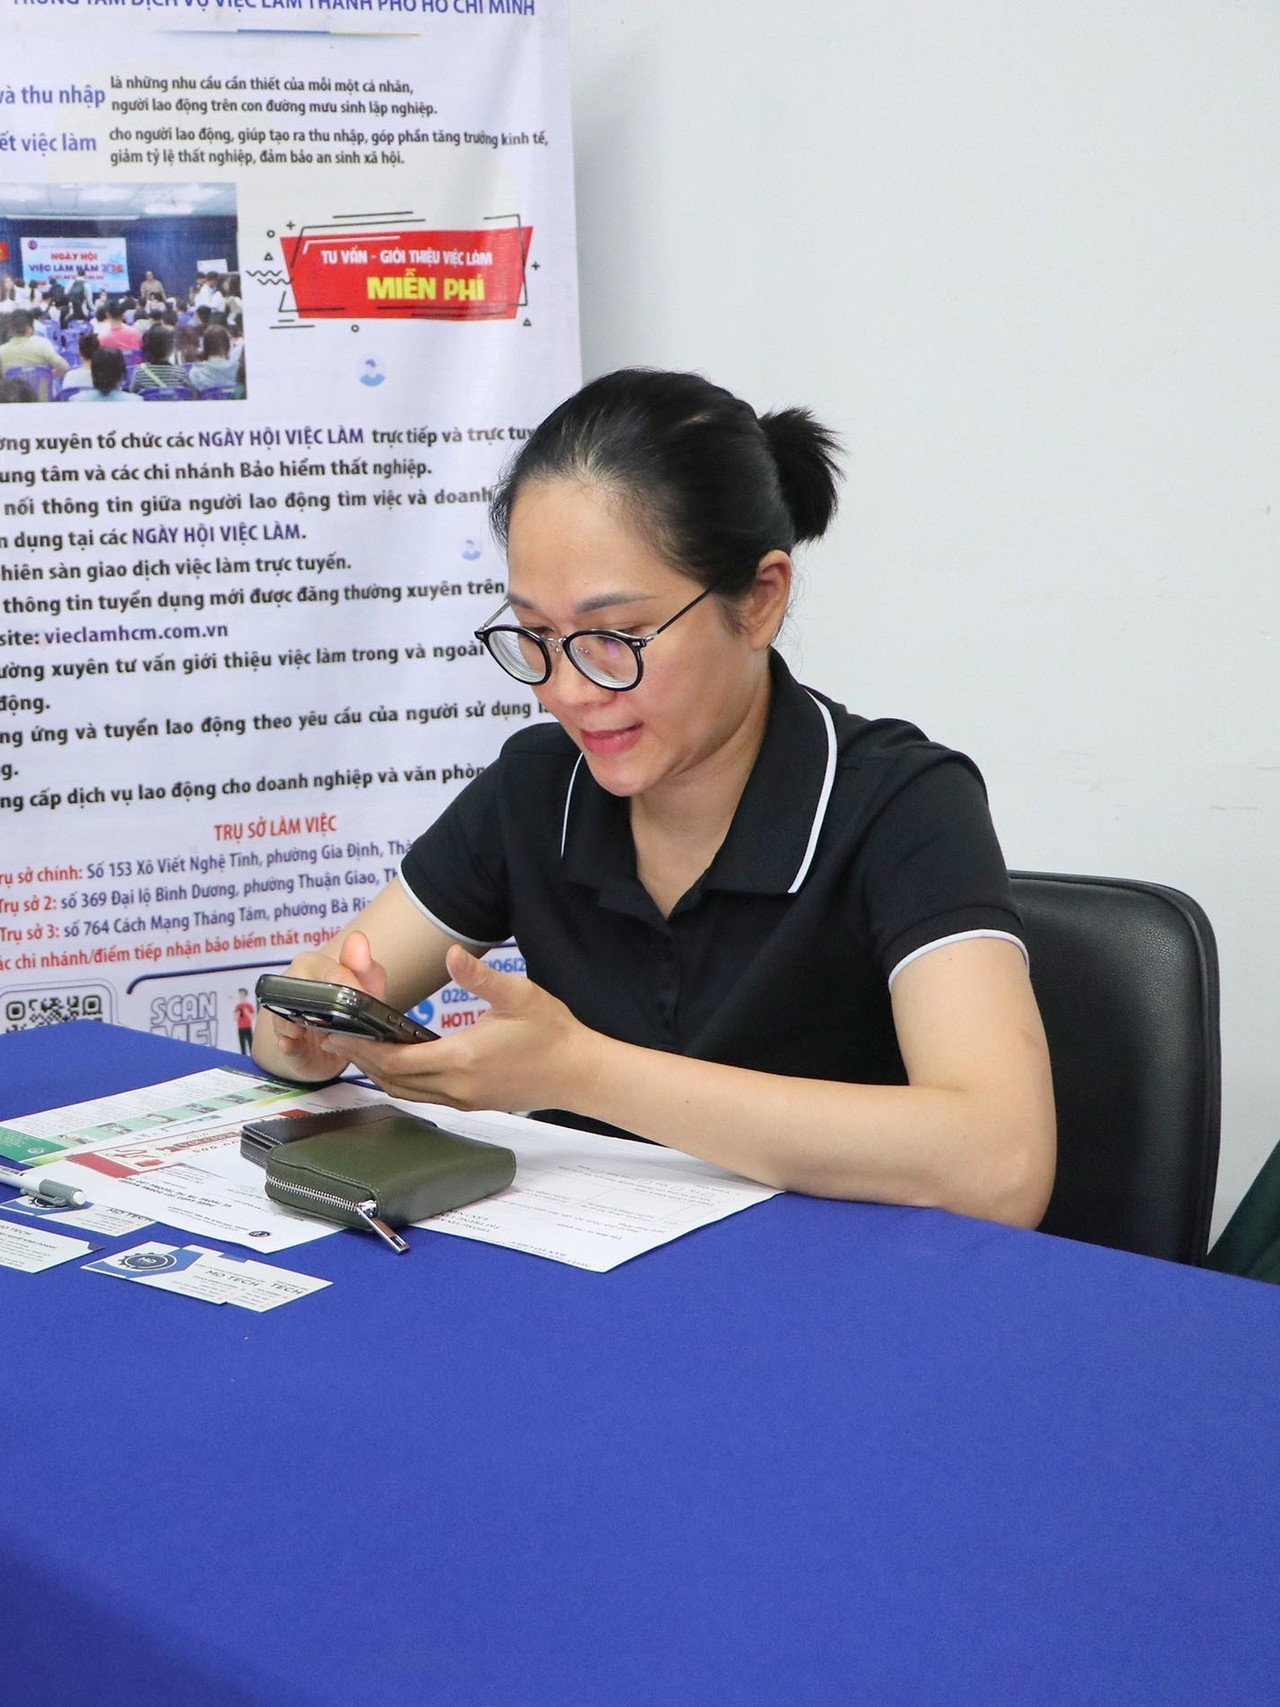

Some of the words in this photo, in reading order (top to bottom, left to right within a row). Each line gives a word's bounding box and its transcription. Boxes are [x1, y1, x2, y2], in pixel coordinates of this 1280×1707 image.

[21, 85, 53, 104] thu
[59, 85, 105, 108] nhập
[112, 98, 149, 115] người
[152, 98, 172, 111] lao
[175, 98, 207, 115] động
[211, 99, 237, 111] trên
[241, 102, 262, 112] con
[266, 99, 306, 116] đường
[309, 102, 337, 113] mưu
[341, 101, 366, 113] sinh
[369, 101, 388, 117] lập
[391, 102, 437, 117] nghiệp.
[21, 133, 57, 156] việc
[62, 133, 96, 151] làm
[367, 268, 438, 300] MIỄN
[444, 273, 485, 302] PHÍ
[41, 466, 79, 482] tâm
[85, 465, 105, 481] và
[111, 464, 139, 480] các
[144, 464, 170, 480] chi
[175, 462, 234, 479] nhánh
[240, 460, 274, 478] Bảo
[280, 459, 325, 476] hiểm
[331, 458, 368, 475] thất
[373, 459, 432, 479] nghiệp.
[14, 532, 63, 552] dụng
[68, 530, 94, 551] tại
[99, 528, 127, 545] các
[133, 526, 178, 544] NGÀY
[184, 524, 214, 547] HỘI
[220, 523, 258, 545] VIỆC
[263, 522, 306, 540] LÀM.
[44, 625, 228, 644] vieclamhcm.com.vn
[214, 823, 243, 844] TRỤ
[248, 818, 267, 838] SỞ
[270, 816, 301, 836] LÀM
[305, 813, 336, 836] VIỆC
[17, 867, 33, 884] sở
[37, 865, 82, 882] chính:
[87, 861, 104, 879] Số
[109, 861, 132, 877] 153
[137, 859, 154, 875] Xô
[157, 856, 186, 873] Viết
[267, 847, 317, 868] phường
[321, 844, 343, 859] Gia
[346, 842, 383, 860] Định,
[150, 991, 217, 1025] SCAN
